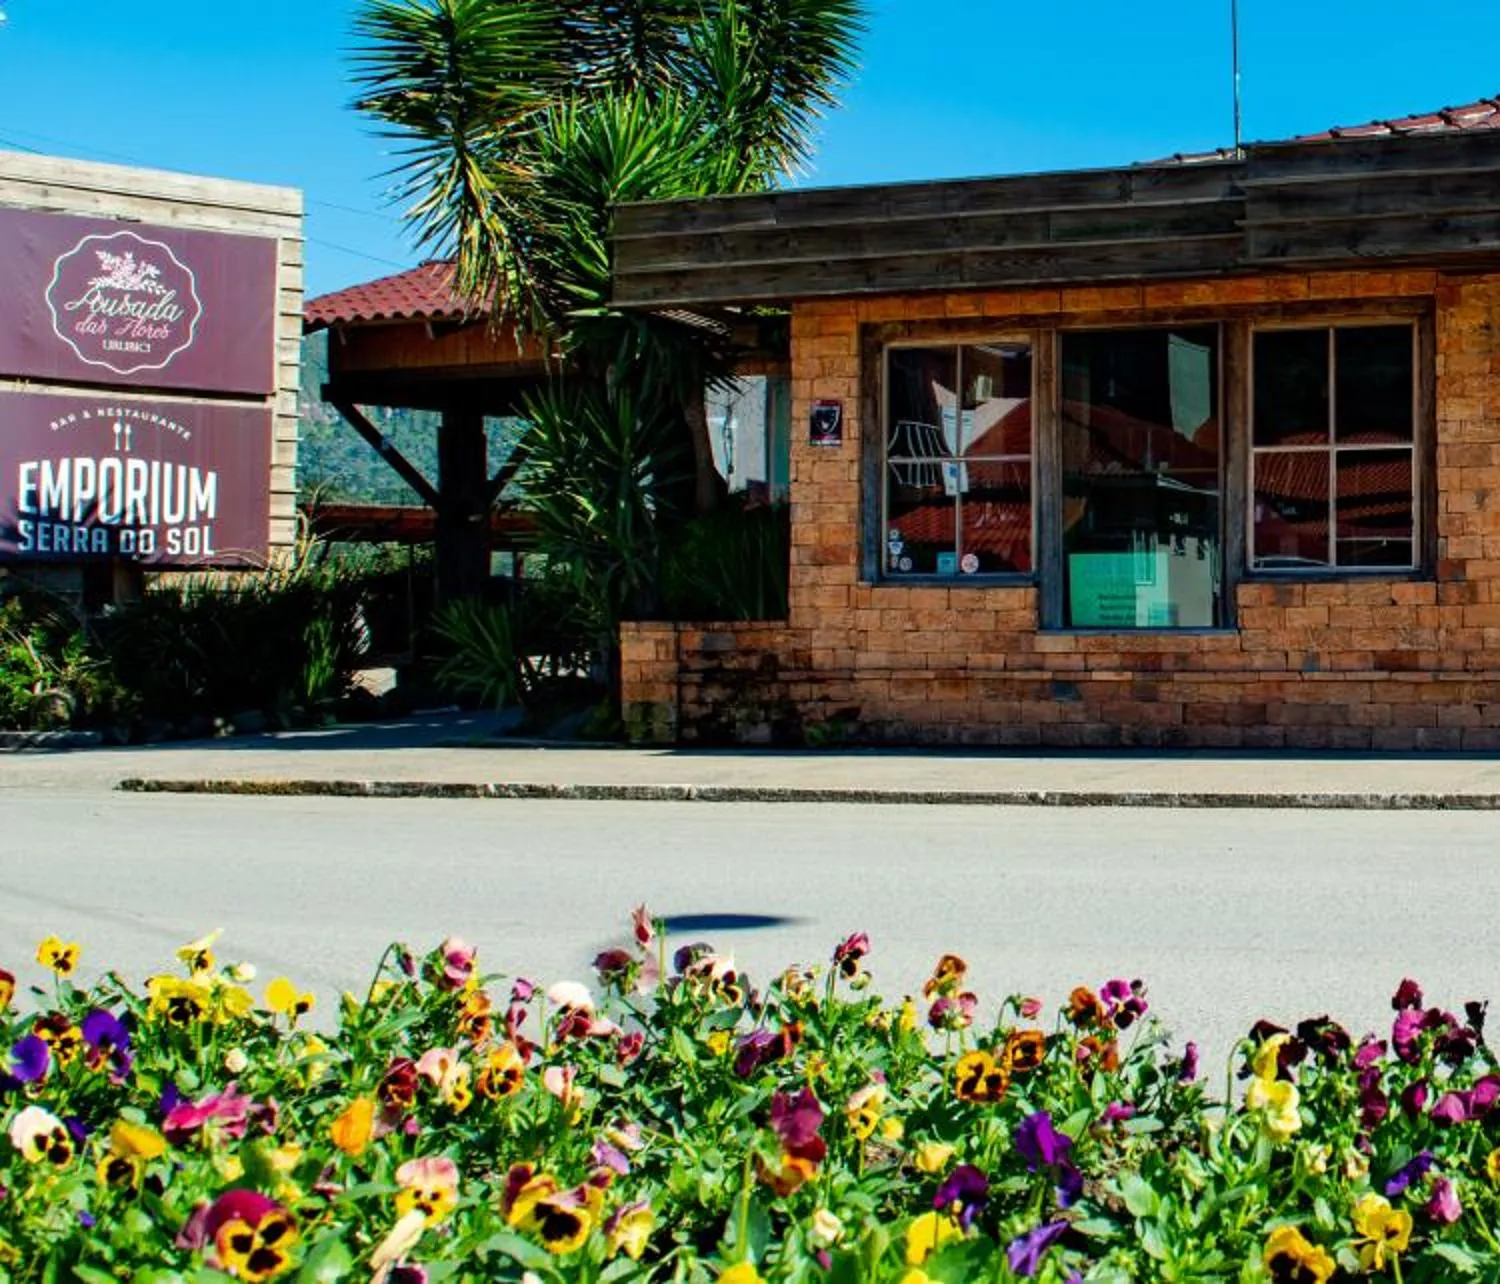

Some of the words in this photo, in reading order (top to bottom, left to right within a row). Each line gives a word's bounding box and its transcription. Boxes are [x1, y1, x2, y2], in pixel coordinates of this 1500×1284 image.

[64, 285, 184, 322] Pousada
[75, 314, 107, 336] das
[114, 316, 171, 339] Flores
[49, 412, 76, 431] BAR
[97, 407, 192, 440] RESTAURANTE
[18, 456, 217, 526] EMPORIUM
[17, 519, 108, 553] SERRA
[119, 528, 155, 555] DO
[166, 525, 215, 556] SOL
